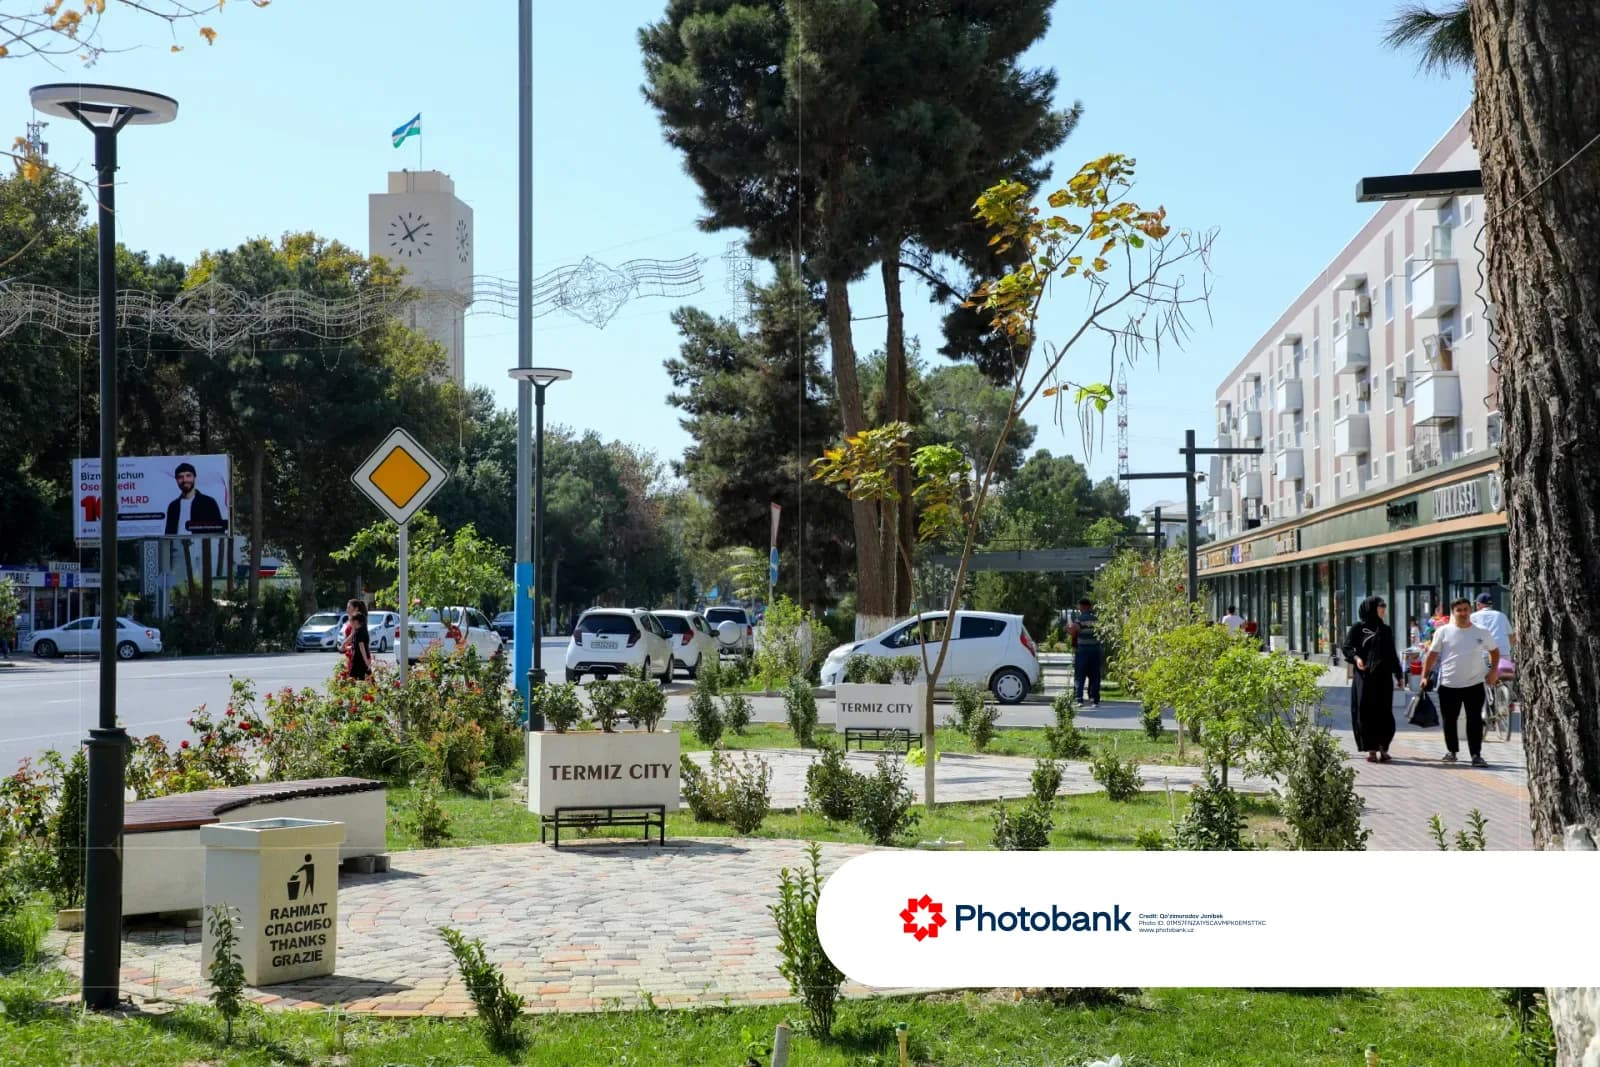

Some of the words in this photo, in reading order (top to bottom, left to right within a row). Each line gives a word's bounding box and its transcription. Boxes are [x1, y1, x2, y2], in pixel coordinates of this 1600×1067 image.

[120, 495, 149, 505] MLRD
[840, 702, 883, 713] TERMIZ
[887, 703, 913, 714] CITY
[549, 764, 622, 781] TERMIZ
[629, 763, 673, 779] CITY
[270, 902, 328, 920] RAHMAT
[264, 918, 332, 937] СПАСИБО
[270, 933, 327, 951] THANKS
[272, 950, 323, 968] GRAZIE
